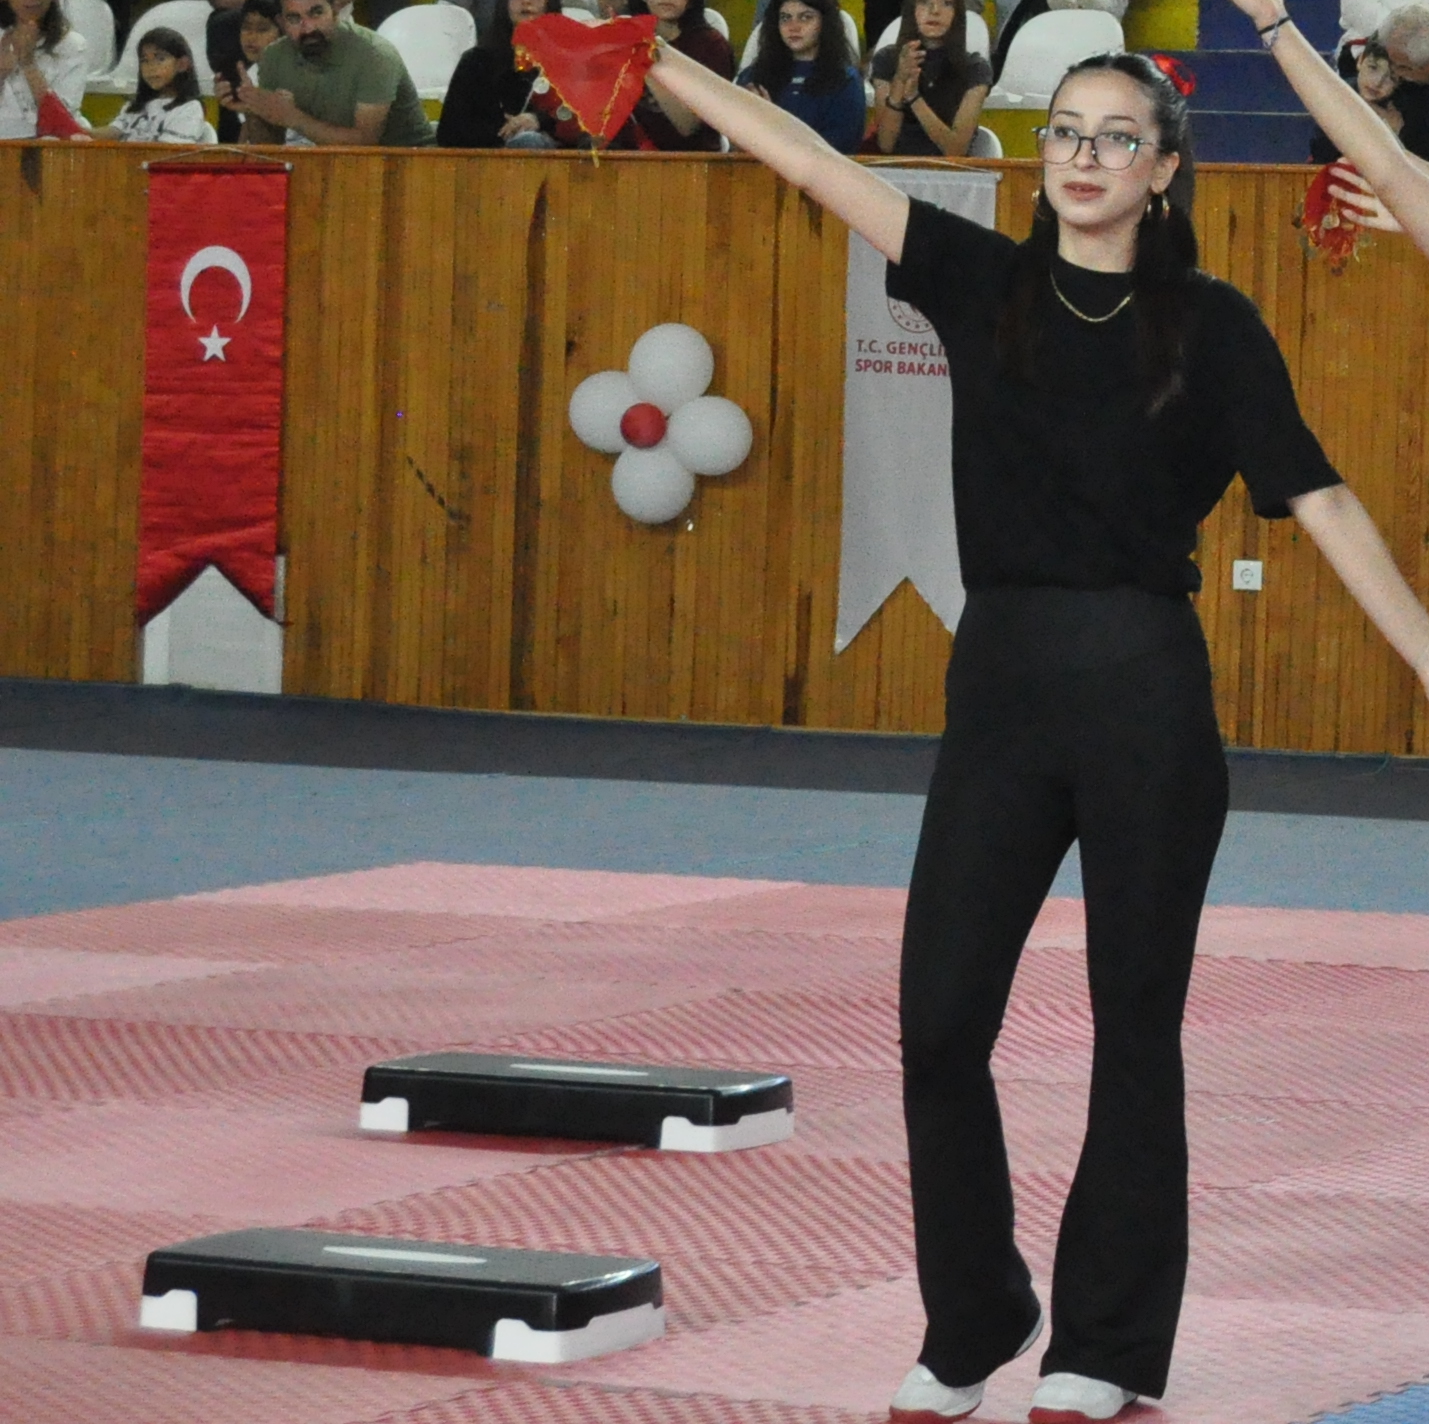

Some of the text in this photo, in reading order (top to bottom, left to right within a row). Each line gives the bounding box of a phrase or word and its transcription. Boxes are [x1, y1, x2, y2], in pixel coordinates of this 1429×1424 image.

[857, 339, 946, 360] T.C. GENÇLİ
[855, 359, 948, 377] SPOR BAKAN
